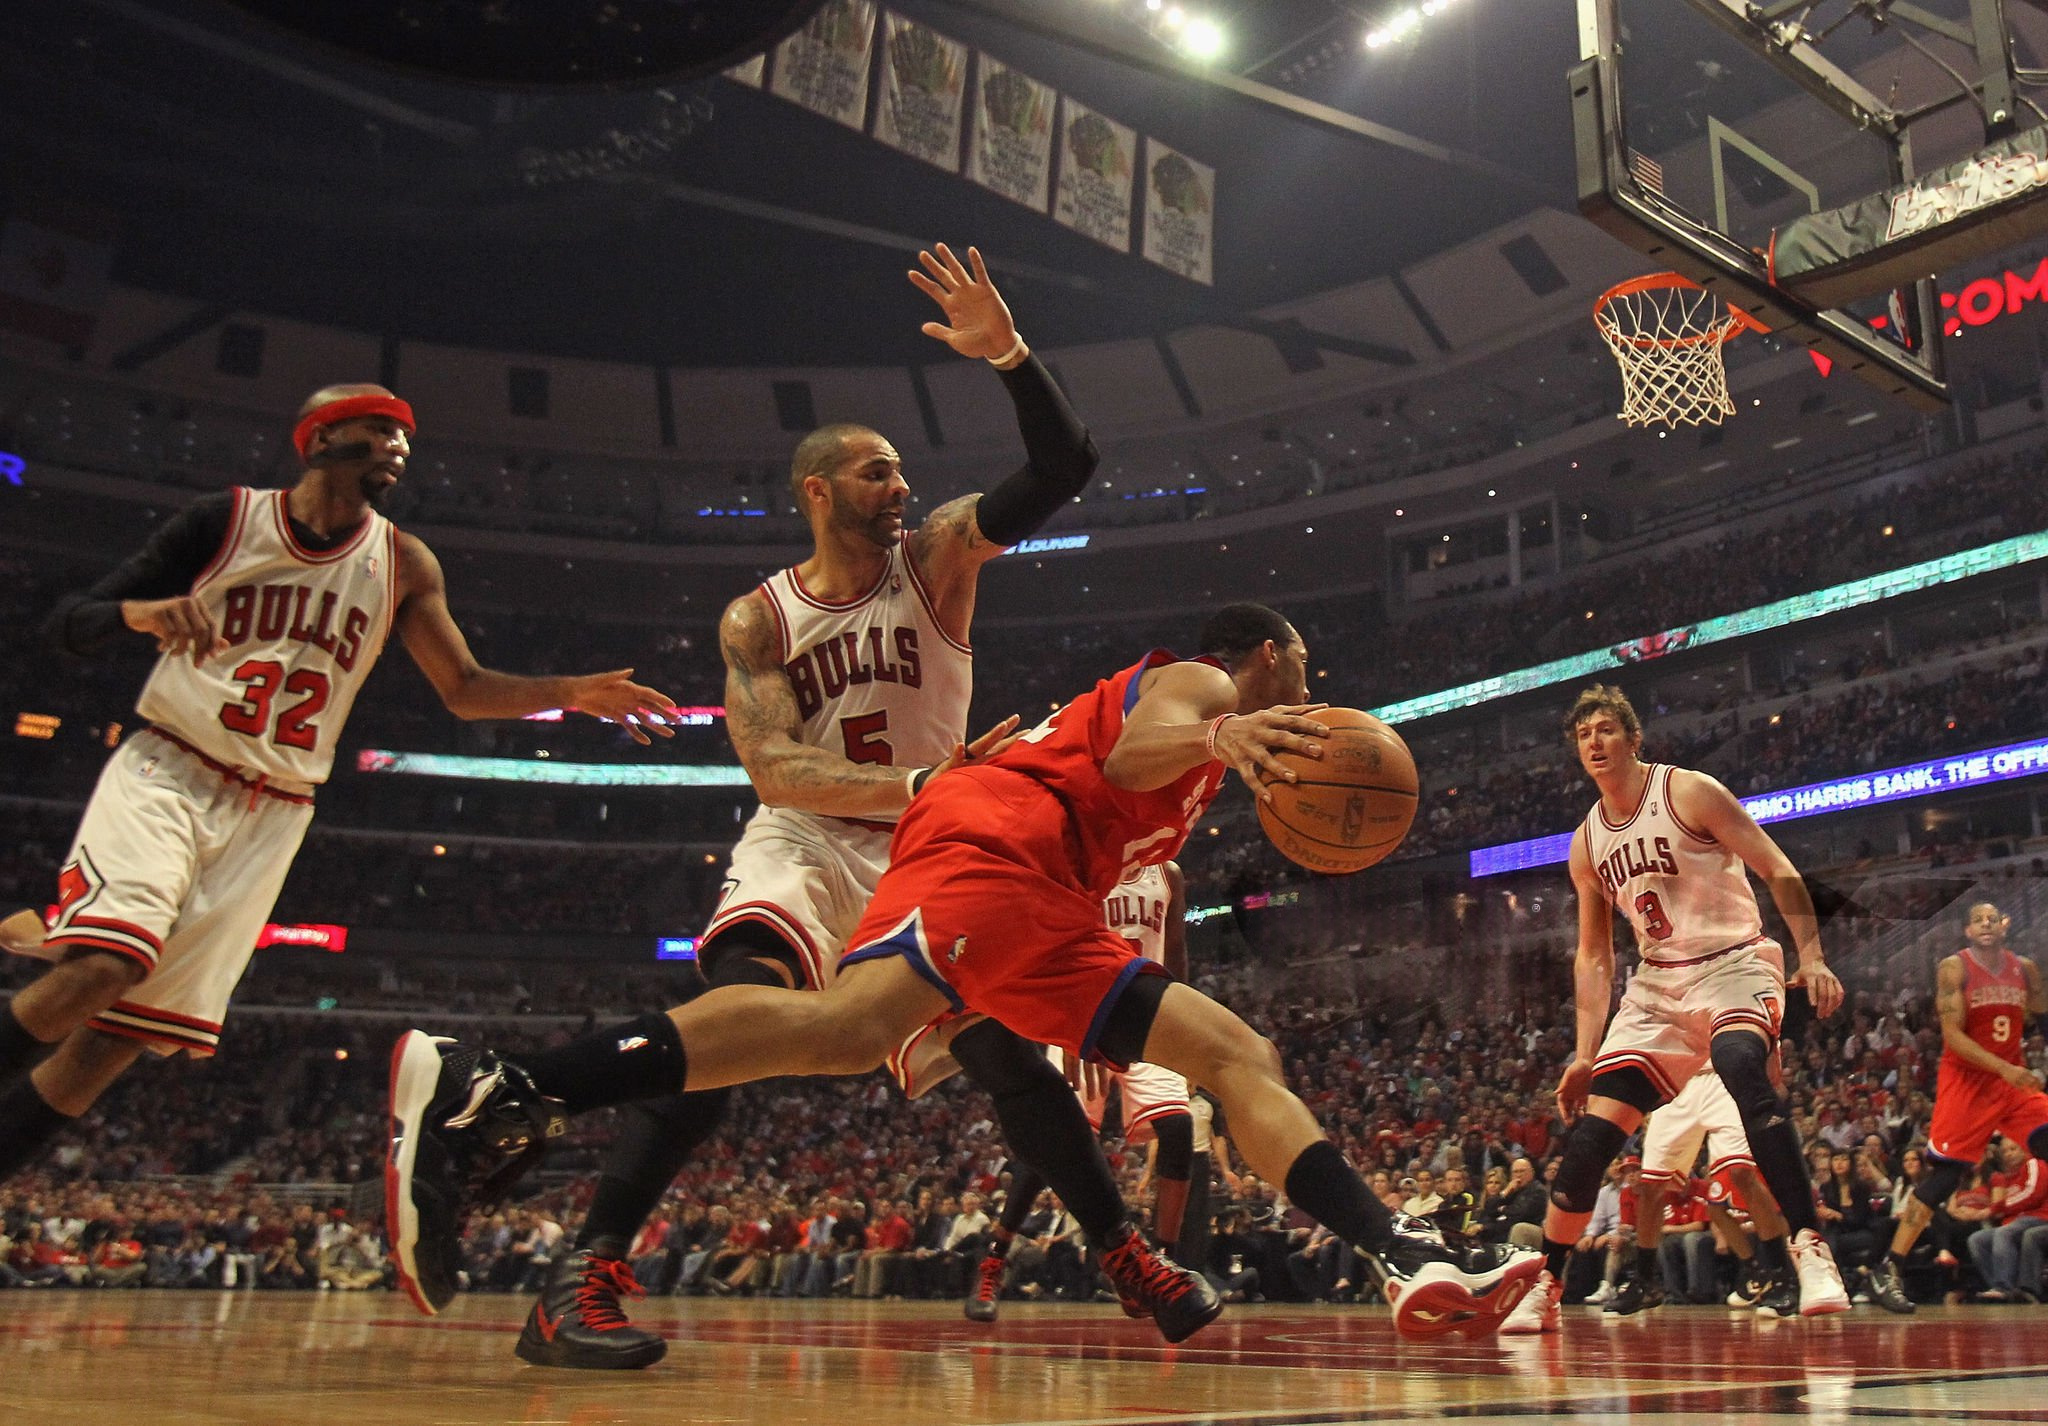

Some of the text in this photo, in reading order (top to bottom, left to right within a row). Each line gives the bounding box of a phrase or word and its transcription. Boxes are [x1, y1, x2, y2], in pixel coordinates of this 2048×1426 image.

[222, 585, 370, 674] BULLS
[785, 626, 922, 723] BULLS
[218, 659, 330, 752] 32
[840, 709, 893, 766] 5
[1794, 779, 1872, 813] HARRIS
[1944, 756, 1990, 784] THE
[1598, 836, 1679, 896] BULLS
[1107, 895, 1164, 934] ULLS
[1634, 889, 1674, 941] 3
[1992, 1014, 2011, 1042] 9
